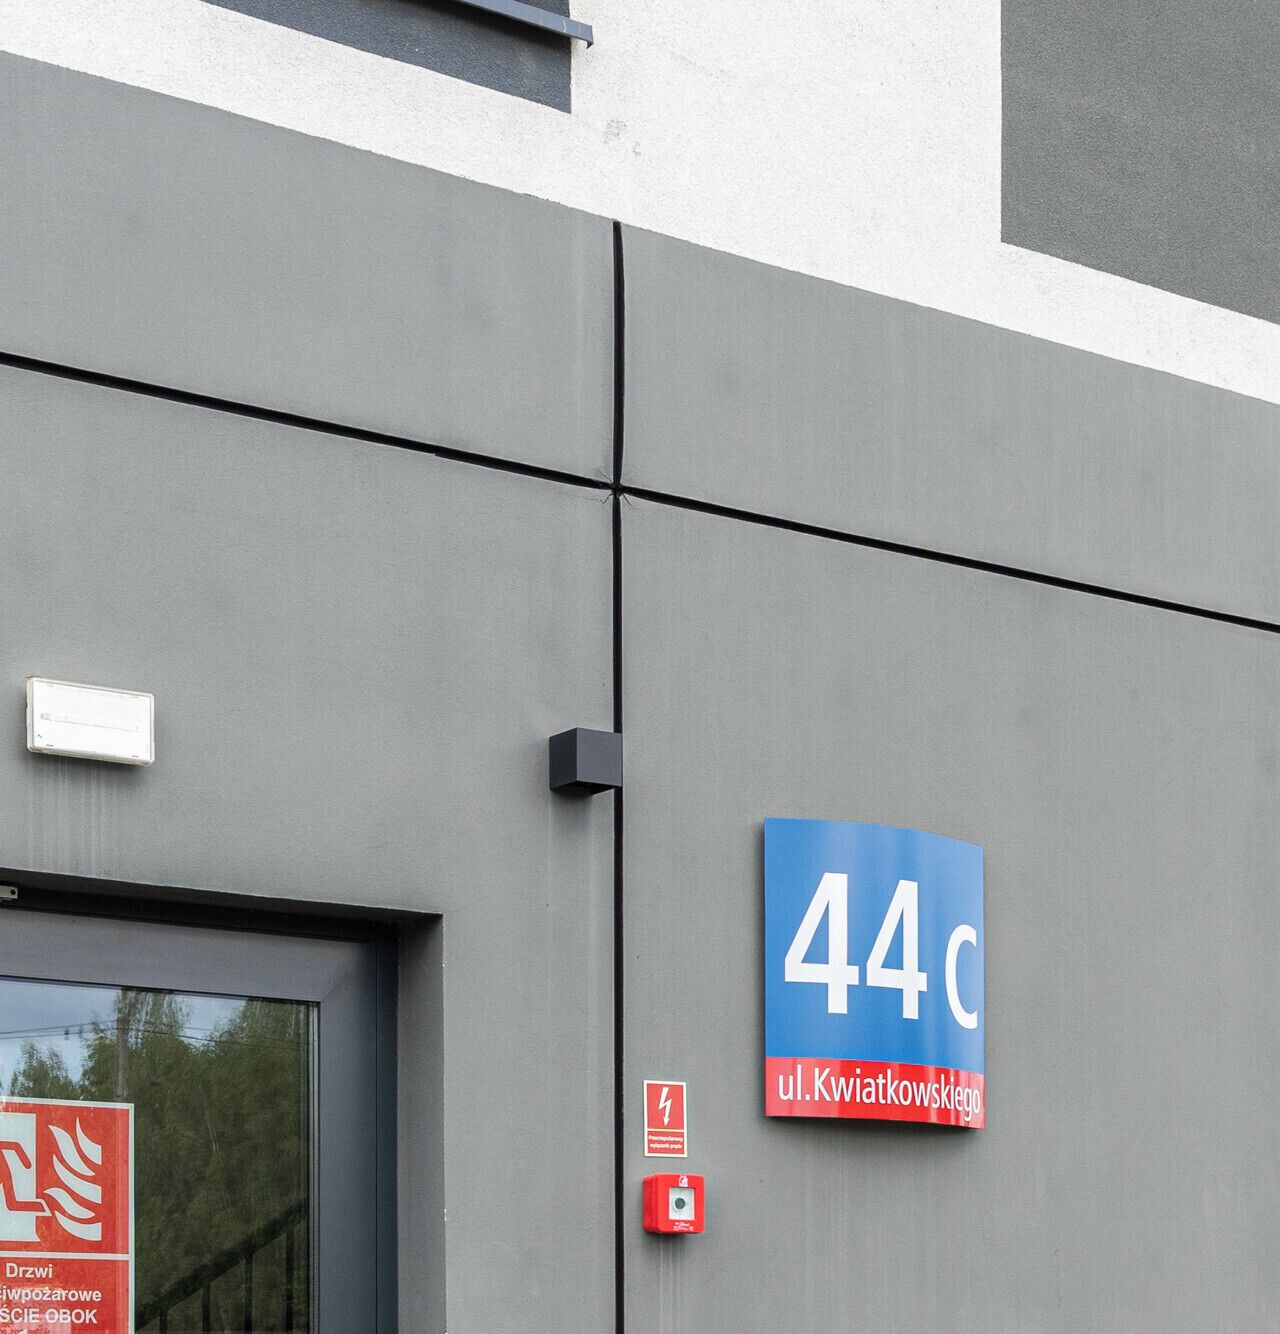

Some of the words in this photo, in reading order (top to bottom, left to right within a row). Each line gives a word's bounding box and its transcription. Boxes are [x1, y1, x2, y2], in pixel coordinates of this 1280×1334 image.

[784, 872, 927, 1020] 44
[5, 1262, 53, 1279] Drzwi
[44, 1308, 98, 1324] OBOK
